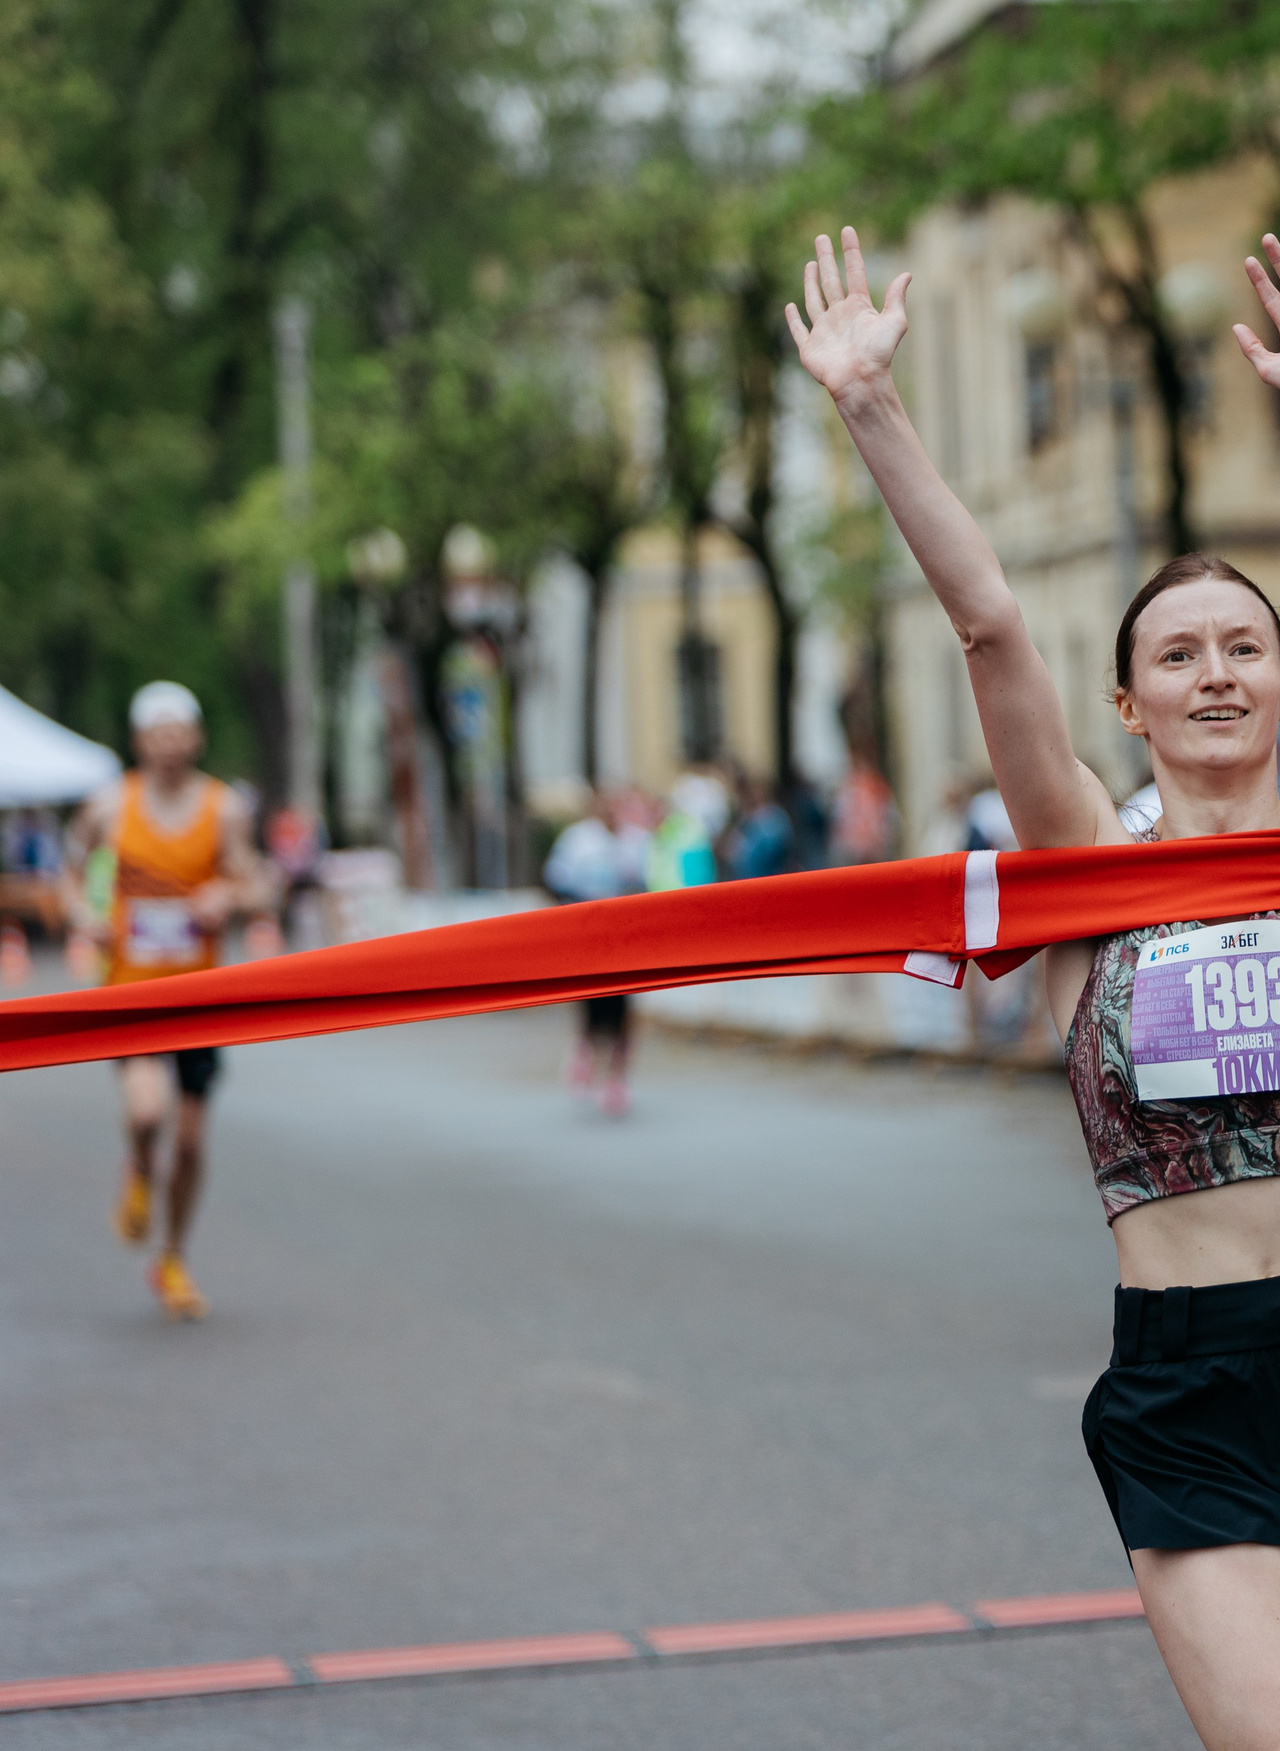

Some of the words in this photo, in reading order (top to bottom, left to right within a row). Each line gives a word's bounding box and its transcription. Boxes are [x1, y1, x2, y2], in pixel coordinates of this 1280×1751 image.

[1166, 942, 1190, 957] ПСБ
[1140, 1014, 1161, 1026] ДАВНО
[1162, 1012, 1186, 1023] ОТСТАЛ
[1216, 1032, 1274, 1053] ЕЛИЗАВЕТА
